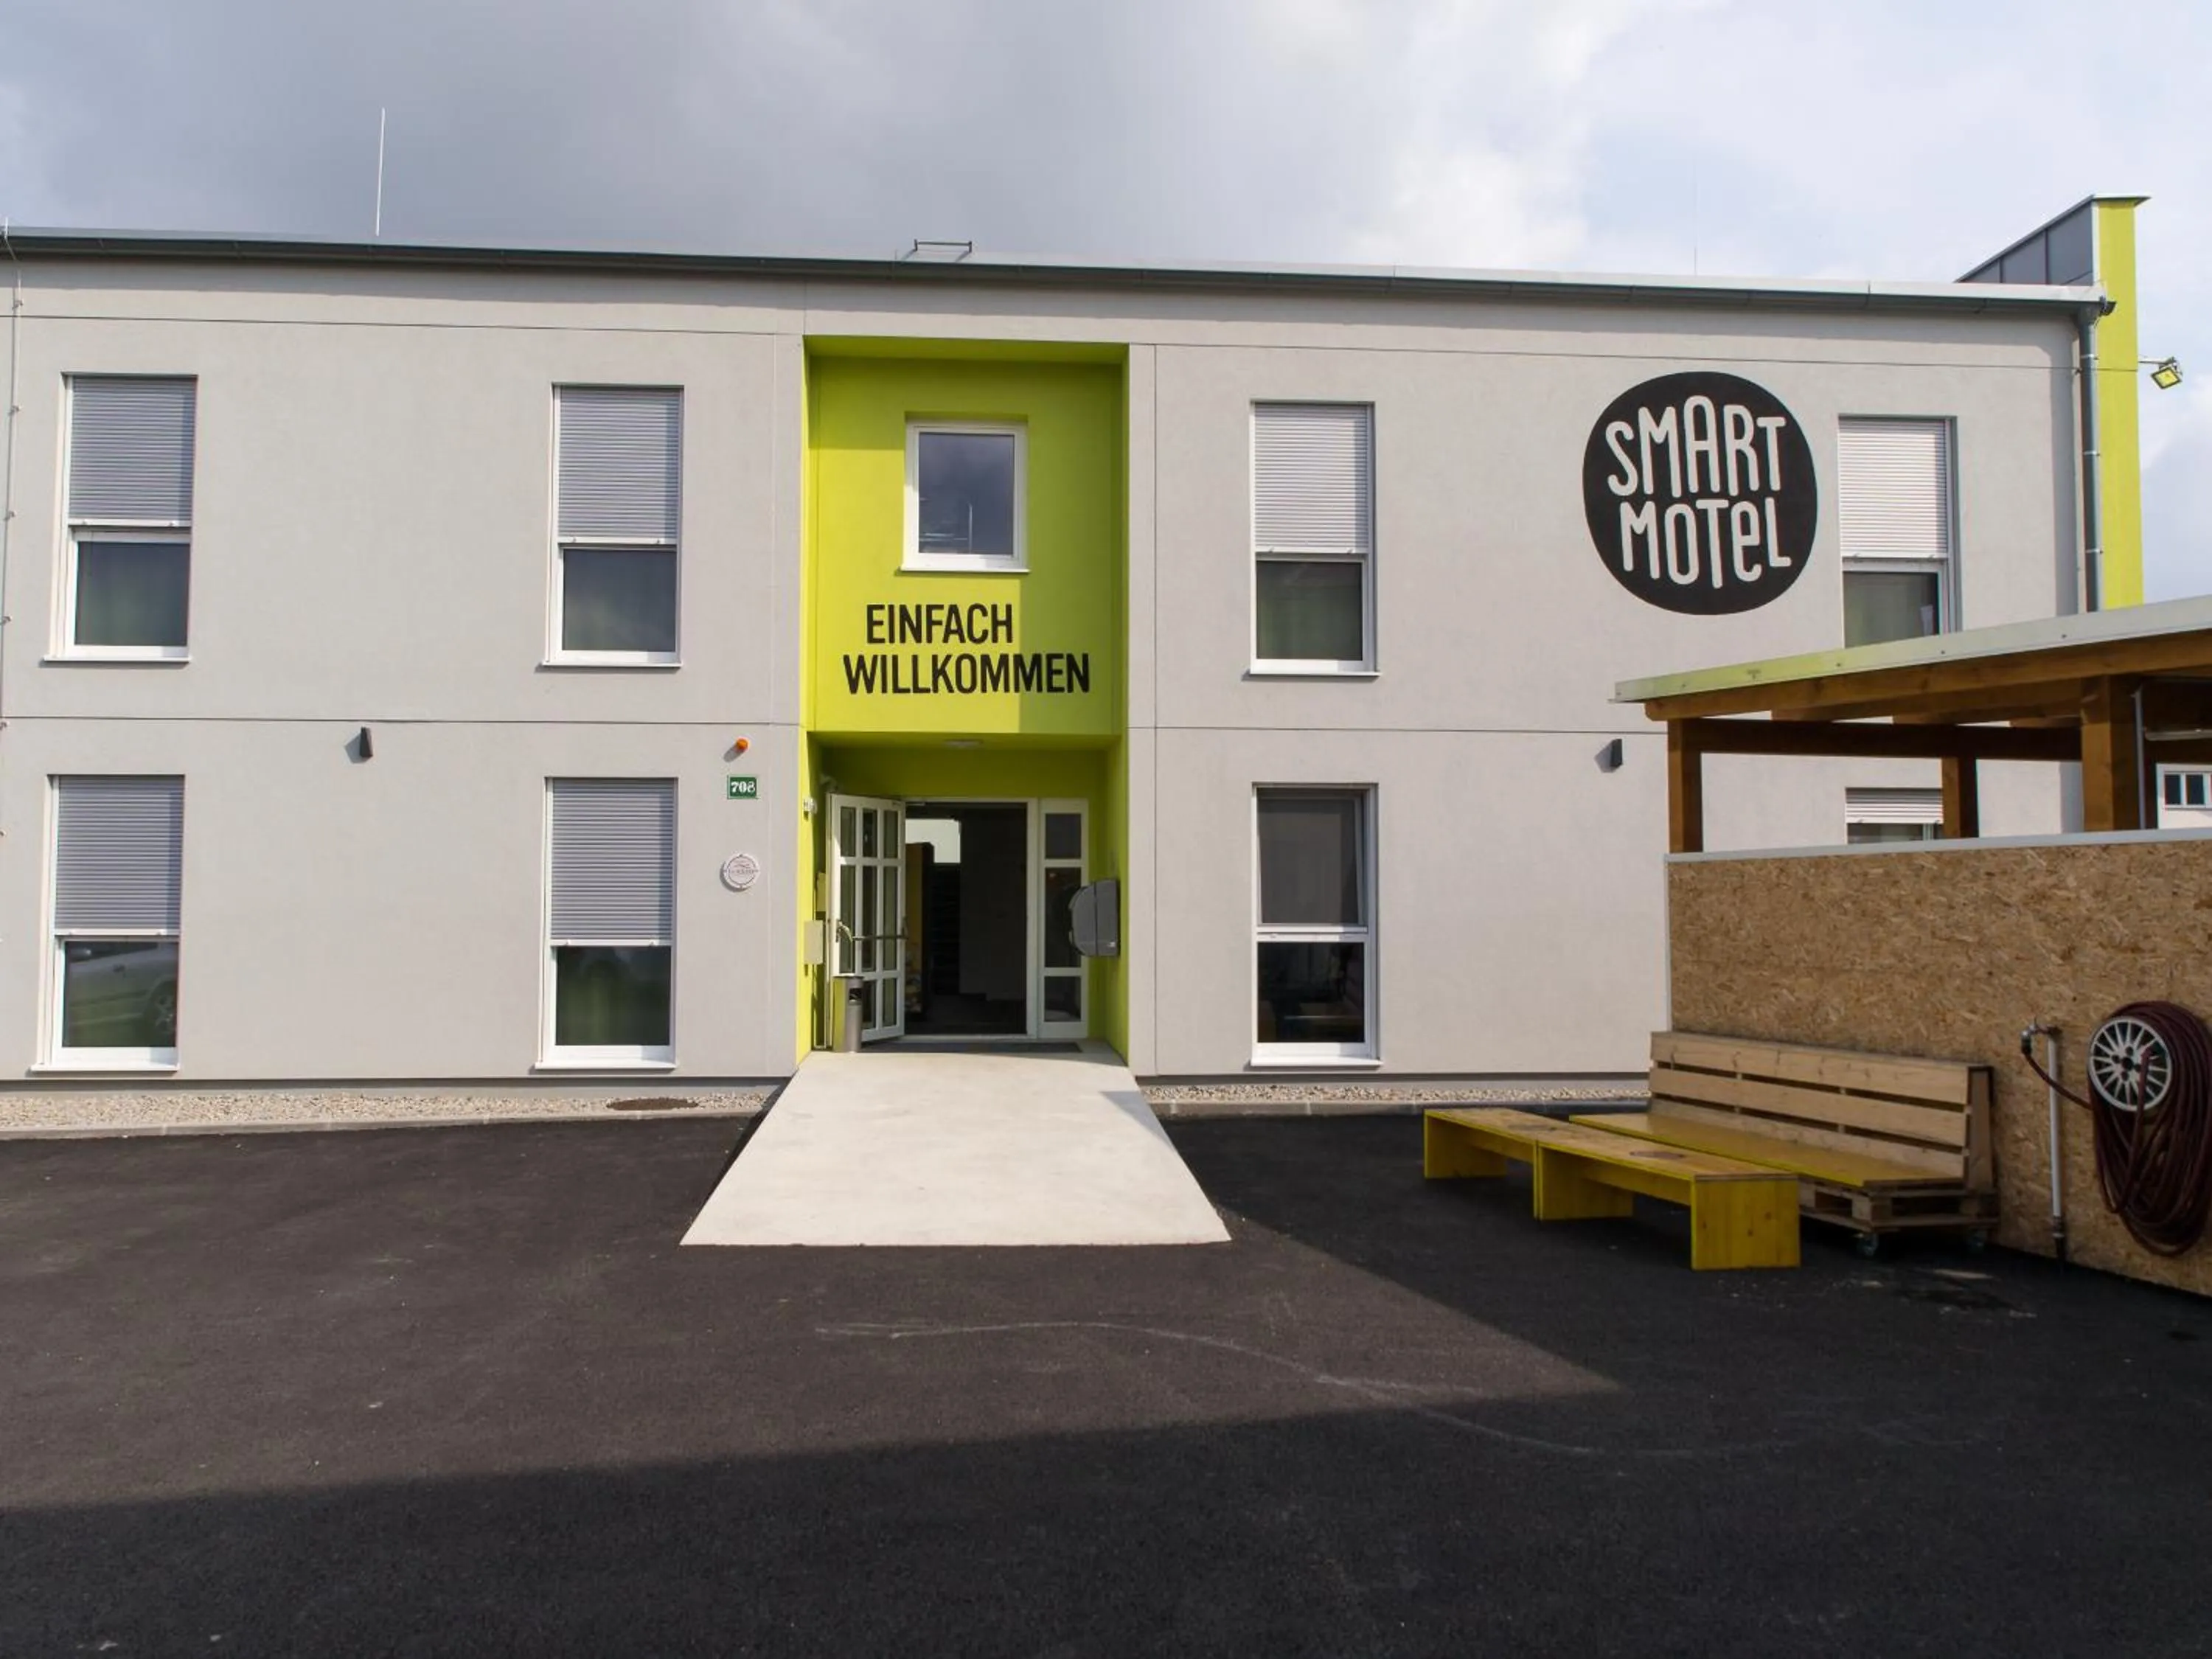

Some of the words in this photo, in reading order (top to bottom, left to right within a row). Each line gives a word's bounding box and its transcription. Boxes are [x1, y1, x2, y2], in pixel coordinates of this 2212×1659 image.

[1605, 395, 1787, 498] SMART
[866, 603, 1013, 644] EINFACH
[843, 653, 1090, 695] WILLKOMMEN
